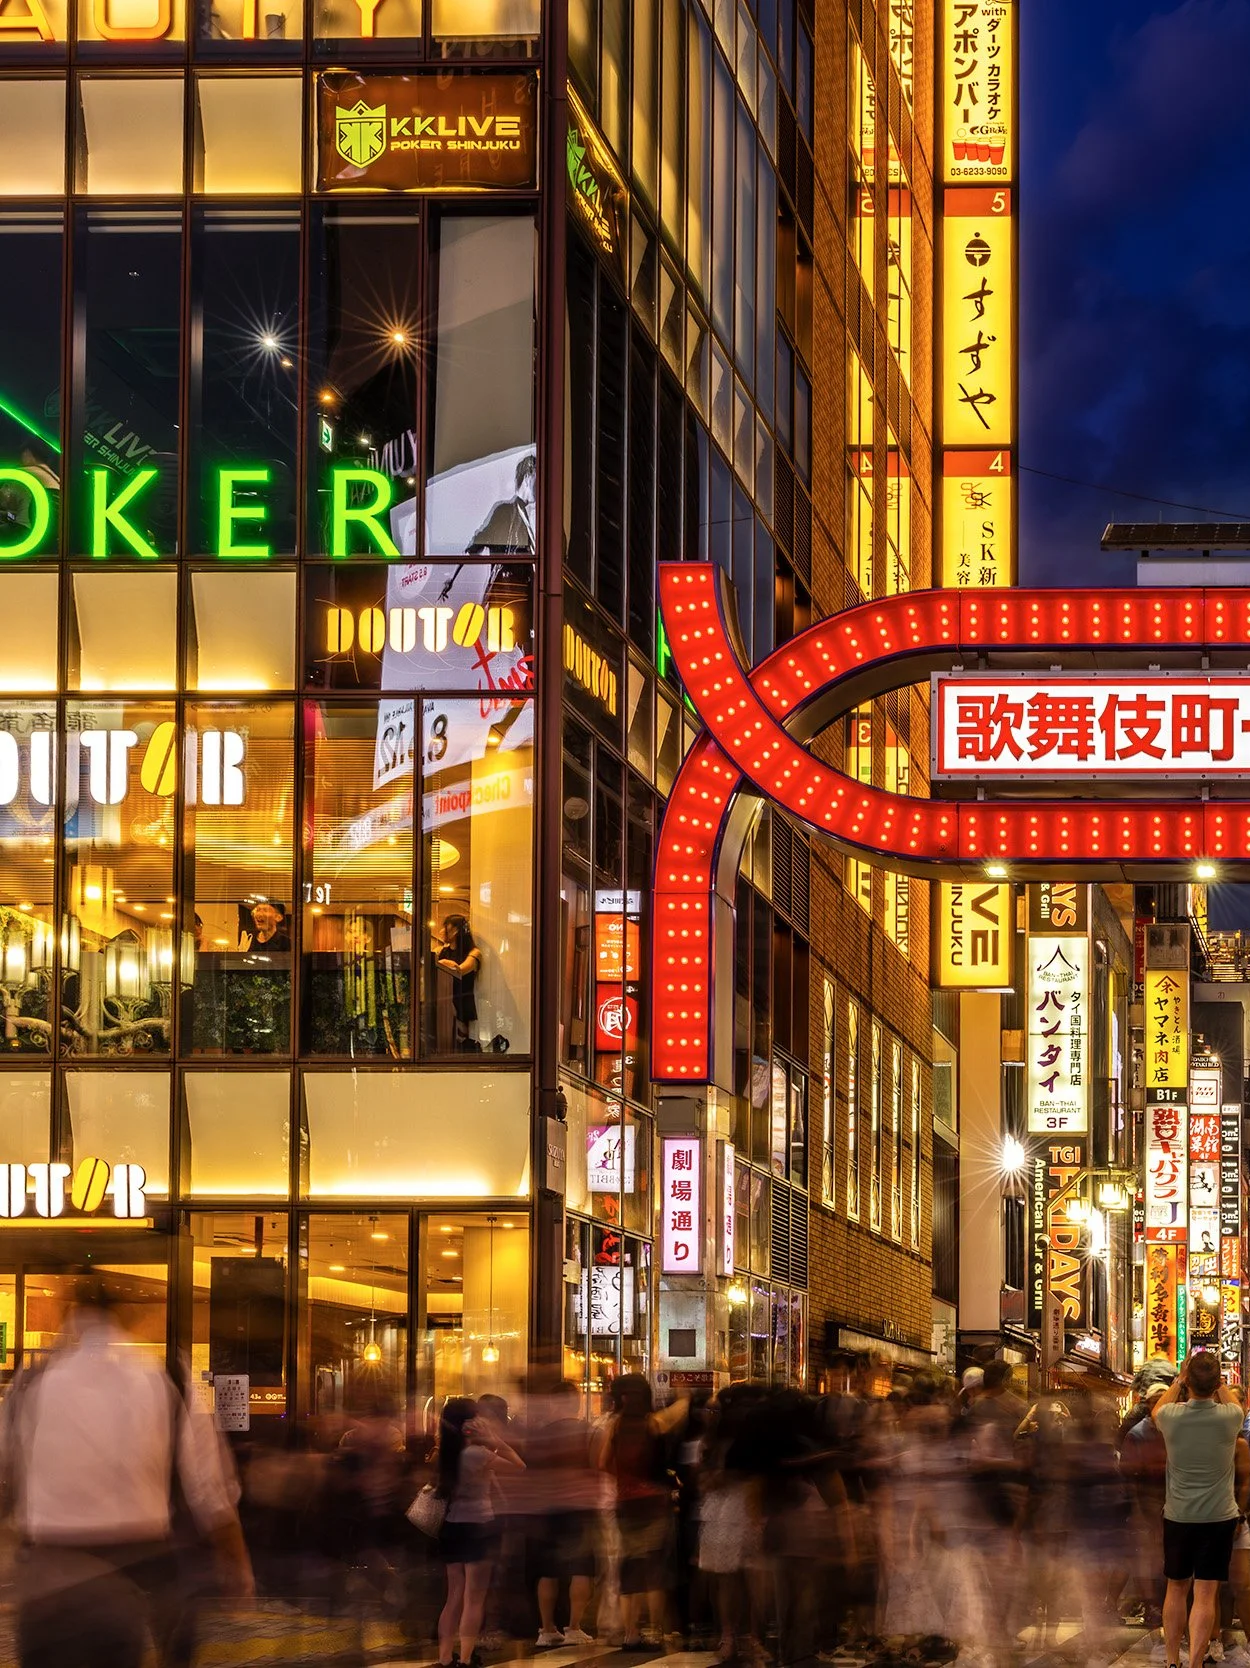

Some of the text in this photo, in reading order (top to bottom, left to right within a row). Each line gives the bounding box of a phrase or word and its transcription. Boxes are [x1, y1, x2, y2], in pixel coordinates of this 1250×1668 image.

[981, 7, 1007, 16] with
[953, 4, 979, 123] アポンバー
[987, 18, 1001, 120] ダーツ カラオケ
[390, 115, 520, 137] KKLIVE
[390, 140, 521, 150] POKER SHINJUKU
[950, 167, 1008, 176] 03-6233-9090
[992, 192, 1006, 213] 5
[988, 452, 1004, 472] 4
[326, 602, 514, 653] DOUTOR
[563, 623, 618, 717] DOUTOR
[1040, 894, 1050, 919] Grill
[1036, 990, 1066, 1094] バンタイ
[1070, 991, 1082, 1086] タイ国料理専門店
[1152, 997, 1170, 1082] ヤマネ肉店
[1156, 1089, 1177, 1101] B1F
[1046, 1118, 1069, 1129] 3F
[1049, 1146, 1081, 1164] TGI
[671, 1149, 693, 1261] 劇場通り
[1034, 1158, 1046, 1229] American
[1155, 1227, 1177, 1240] 4F
